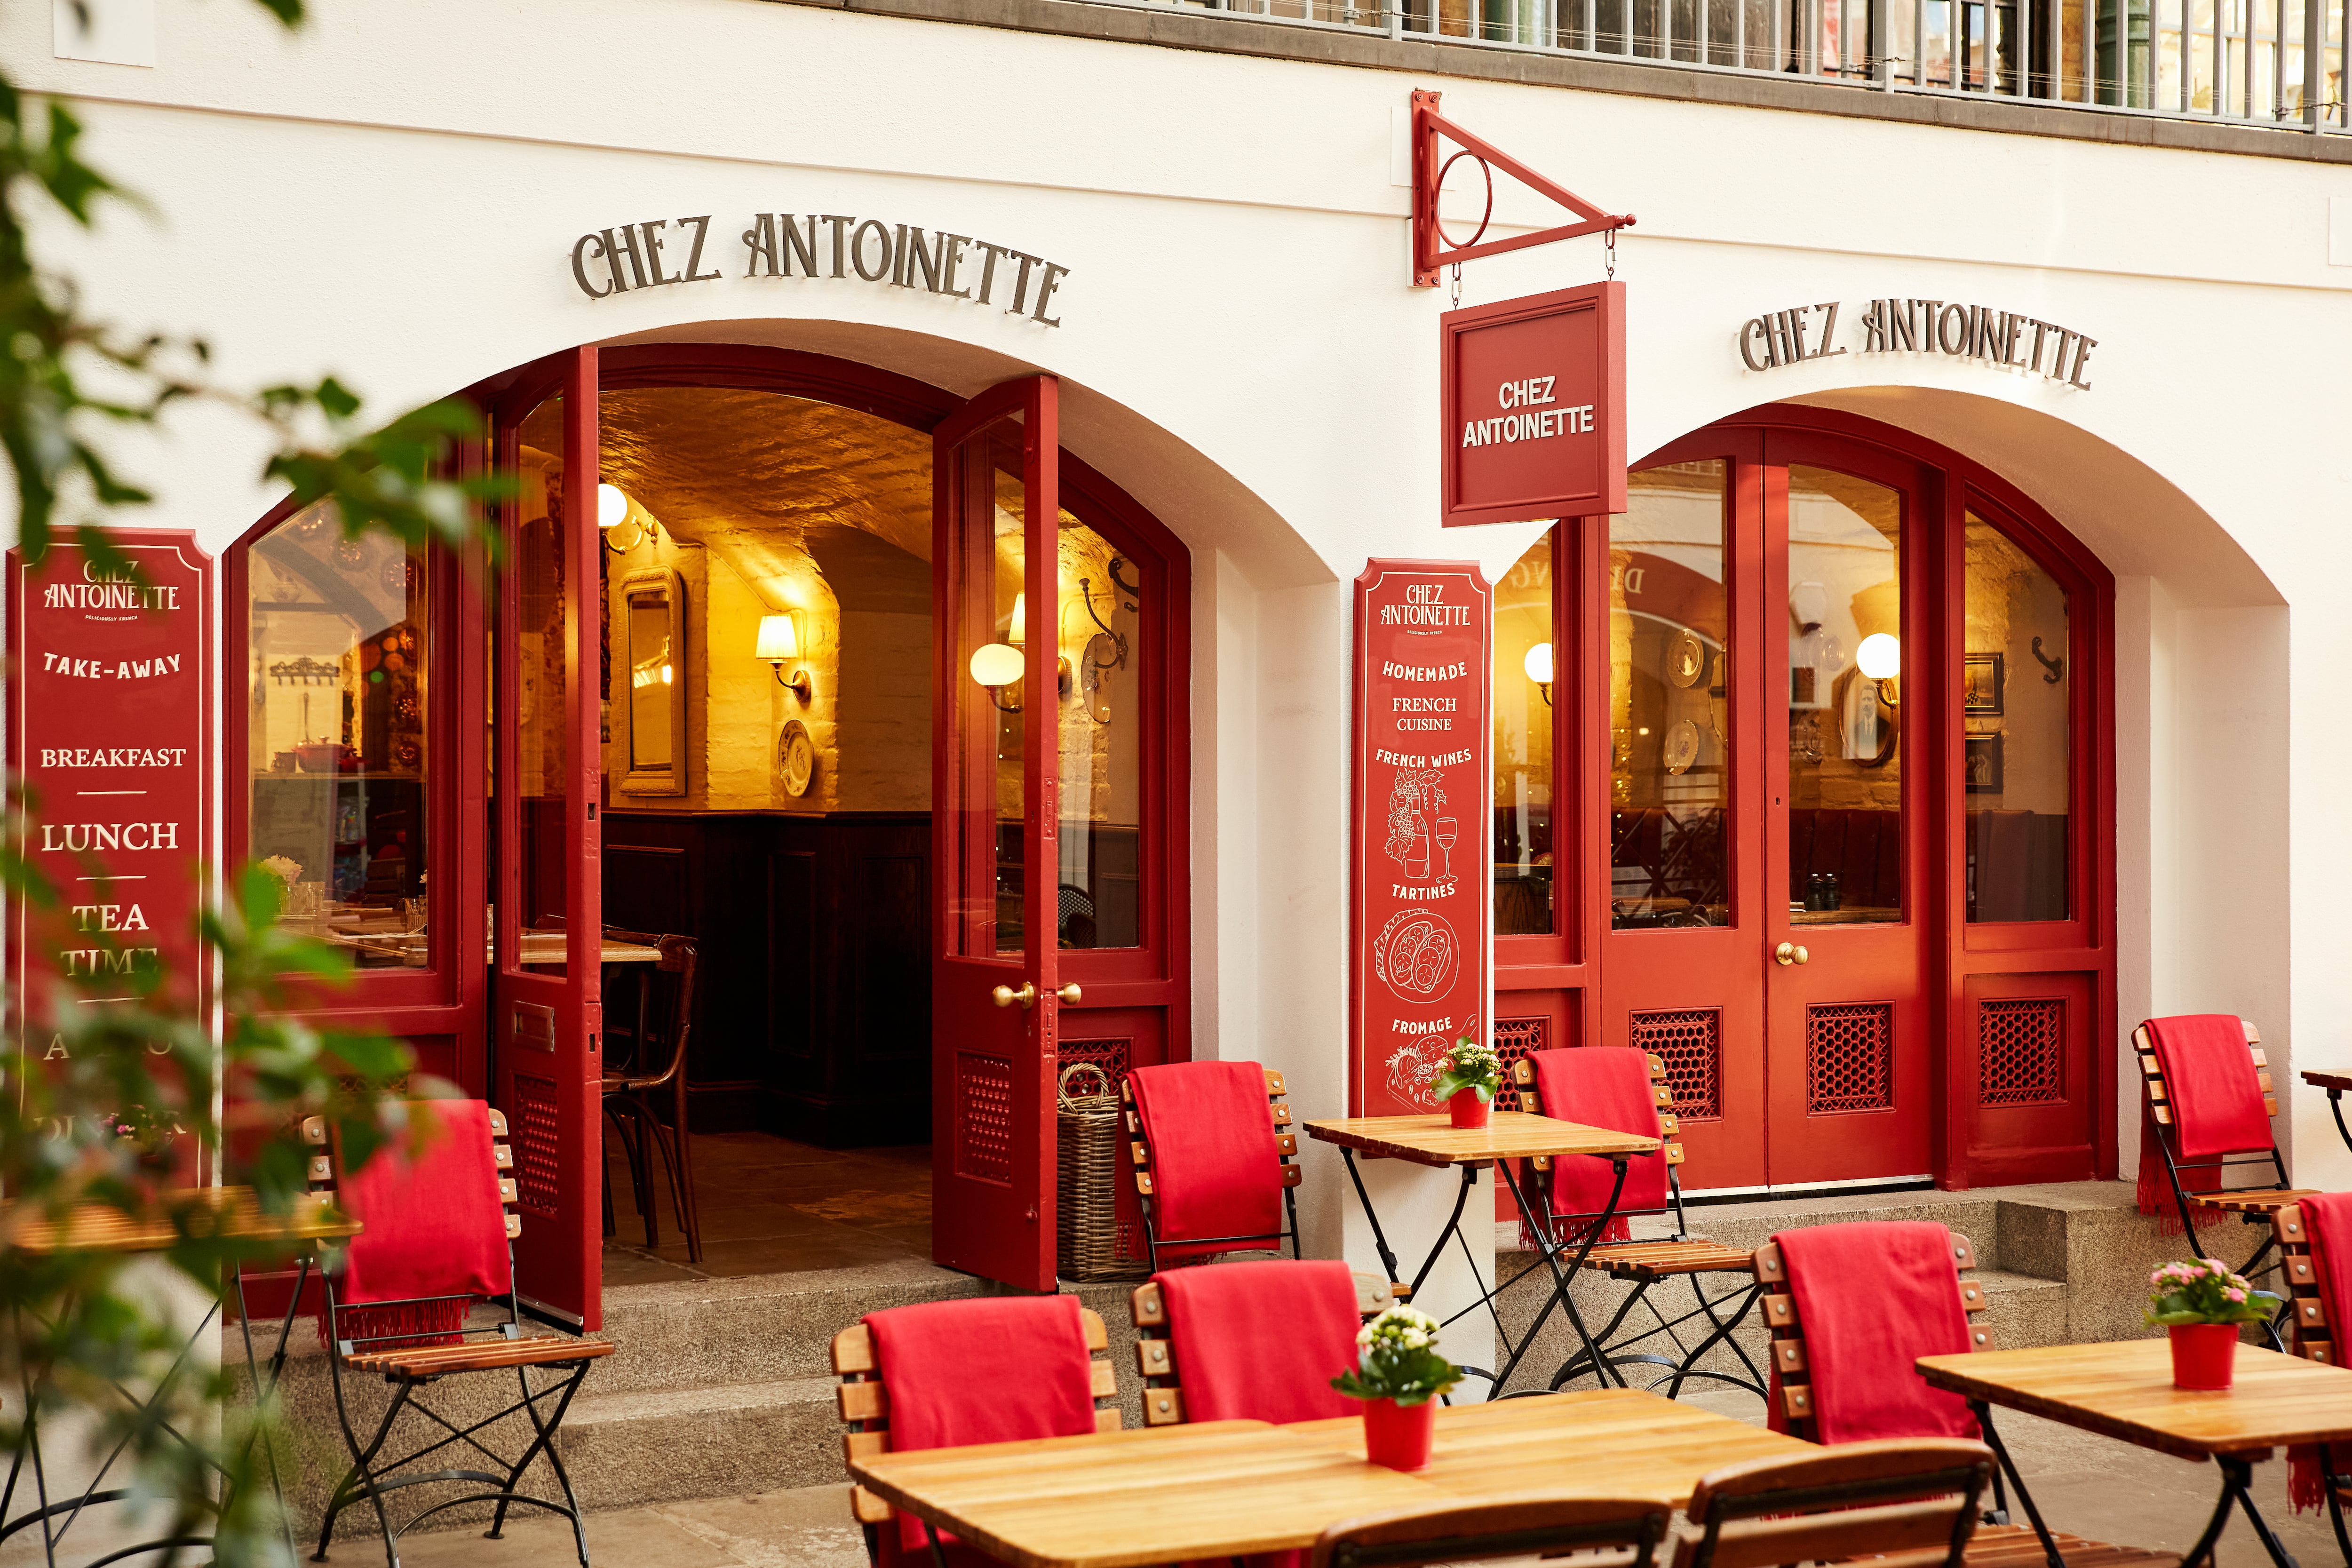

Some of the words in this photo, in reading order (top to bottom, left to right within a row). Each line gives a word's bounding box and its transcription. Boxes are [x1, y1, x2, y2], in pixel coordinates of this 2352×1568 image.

[572, 215, 723, 298] CHEZ
[742, 213, 1071, 328] ANTOINETTE
[1740, 301, 1847, 372] CHEZ
[1862, 298, 2099, 391] ANTOINETTE
[1499, 375, 1556, 409] CHEZ
[1462, 404, 1595, 448] ANTOINETTE
[44, 584, 181, 610] ANTOINETTE
[1406, 584, 1444, 605] CHEZ
[1380, 605, 1471, 626] ANTOINETTE
[44, 652, 181, 679] TAKE-AWAY
[1382, 661, 1468, 682] HOMEMADE
[1392, 698, 1457, 712] FRENCH
[1397, 718, 1452, 731] CUISINE
[40, 748, 187, 767] BREAKFAST
[1375, 748, 1426, 768] FRENCH
[1431, 748, 1472, 768] WINES
[41, 822, 179, 852] LUNCH
[1391, 882, 1455, 900] TARTINES
[72, 903, 150, 932] TEA
[1391, 1016, 1453, 1035] FROMAGE
